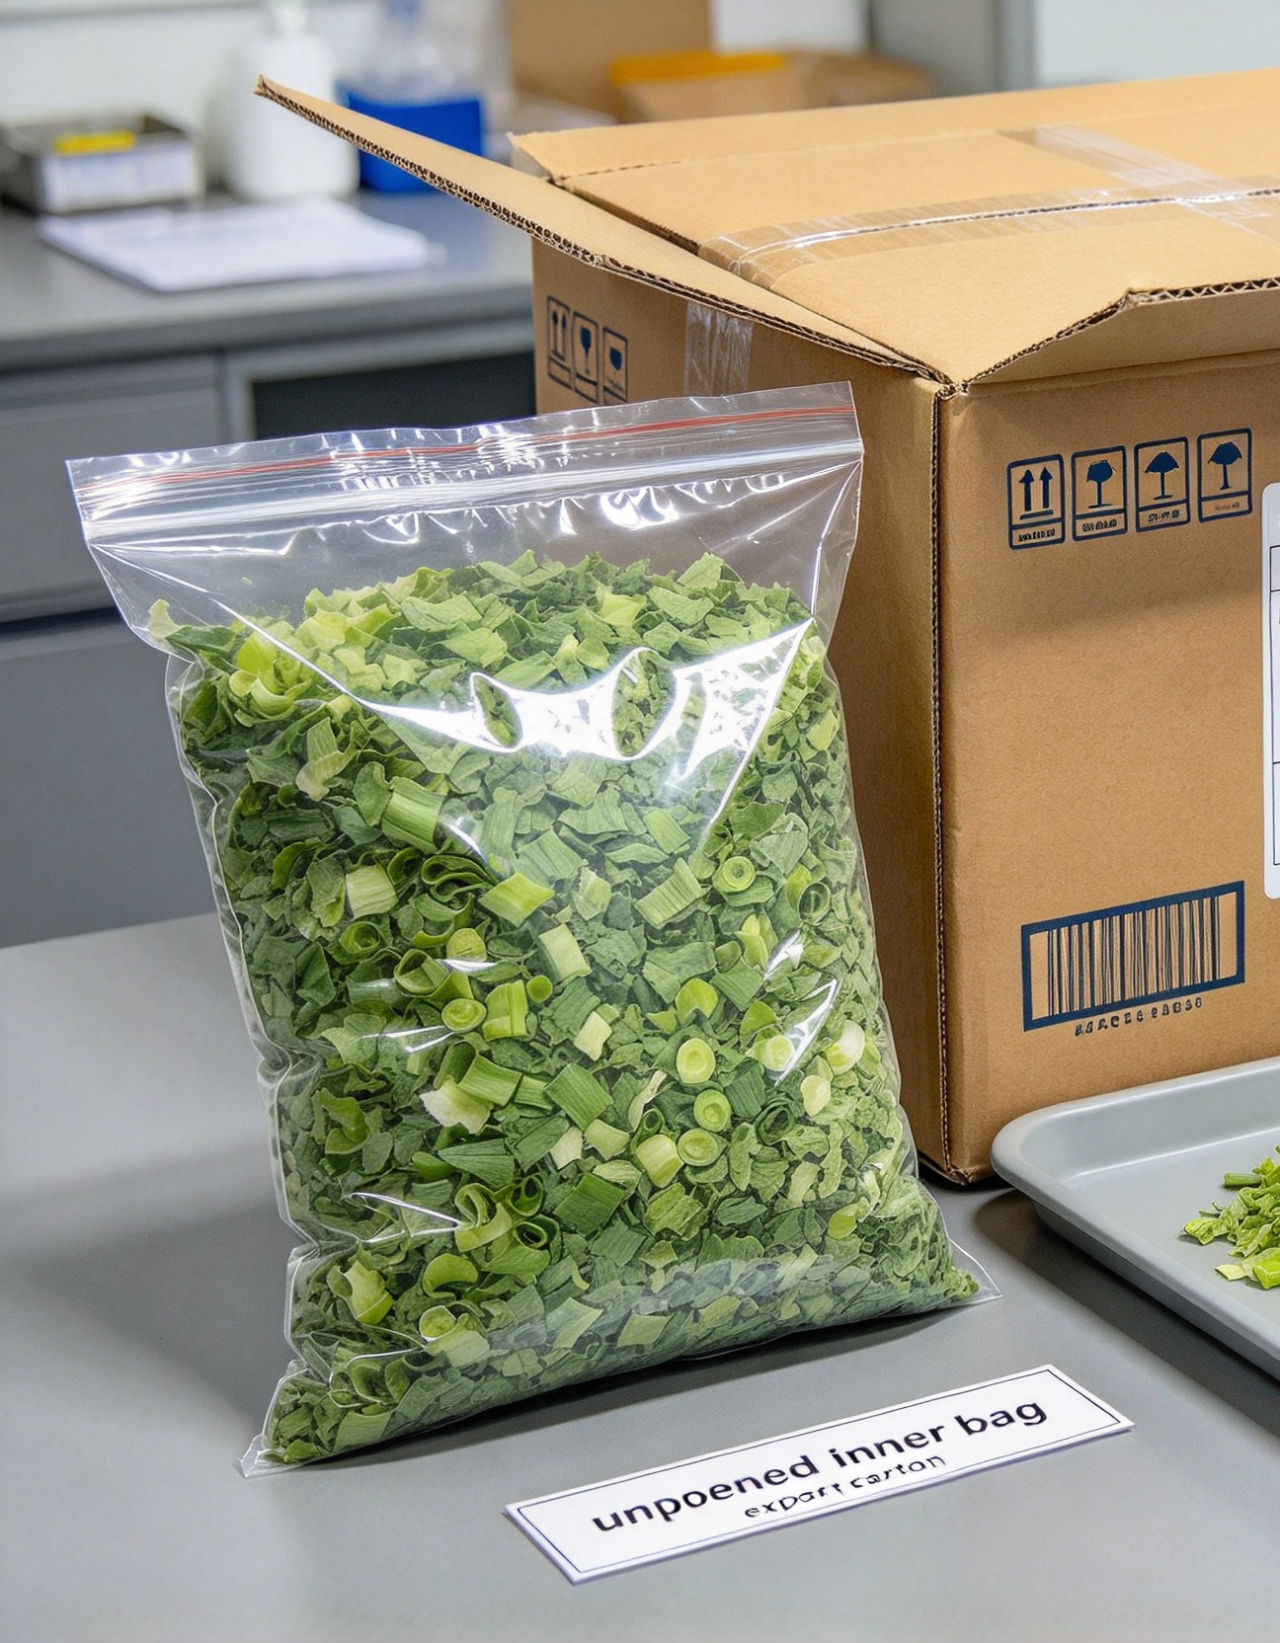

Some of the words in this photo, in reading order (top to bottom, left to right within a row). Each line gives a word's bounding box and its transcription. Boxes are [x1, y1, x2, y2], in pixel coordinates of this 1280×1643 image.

[591, 1454, 821, 1532] unpoened
[828, 1425, 945, 1469] inner
[953, 1402, 1048, 1437] bag
